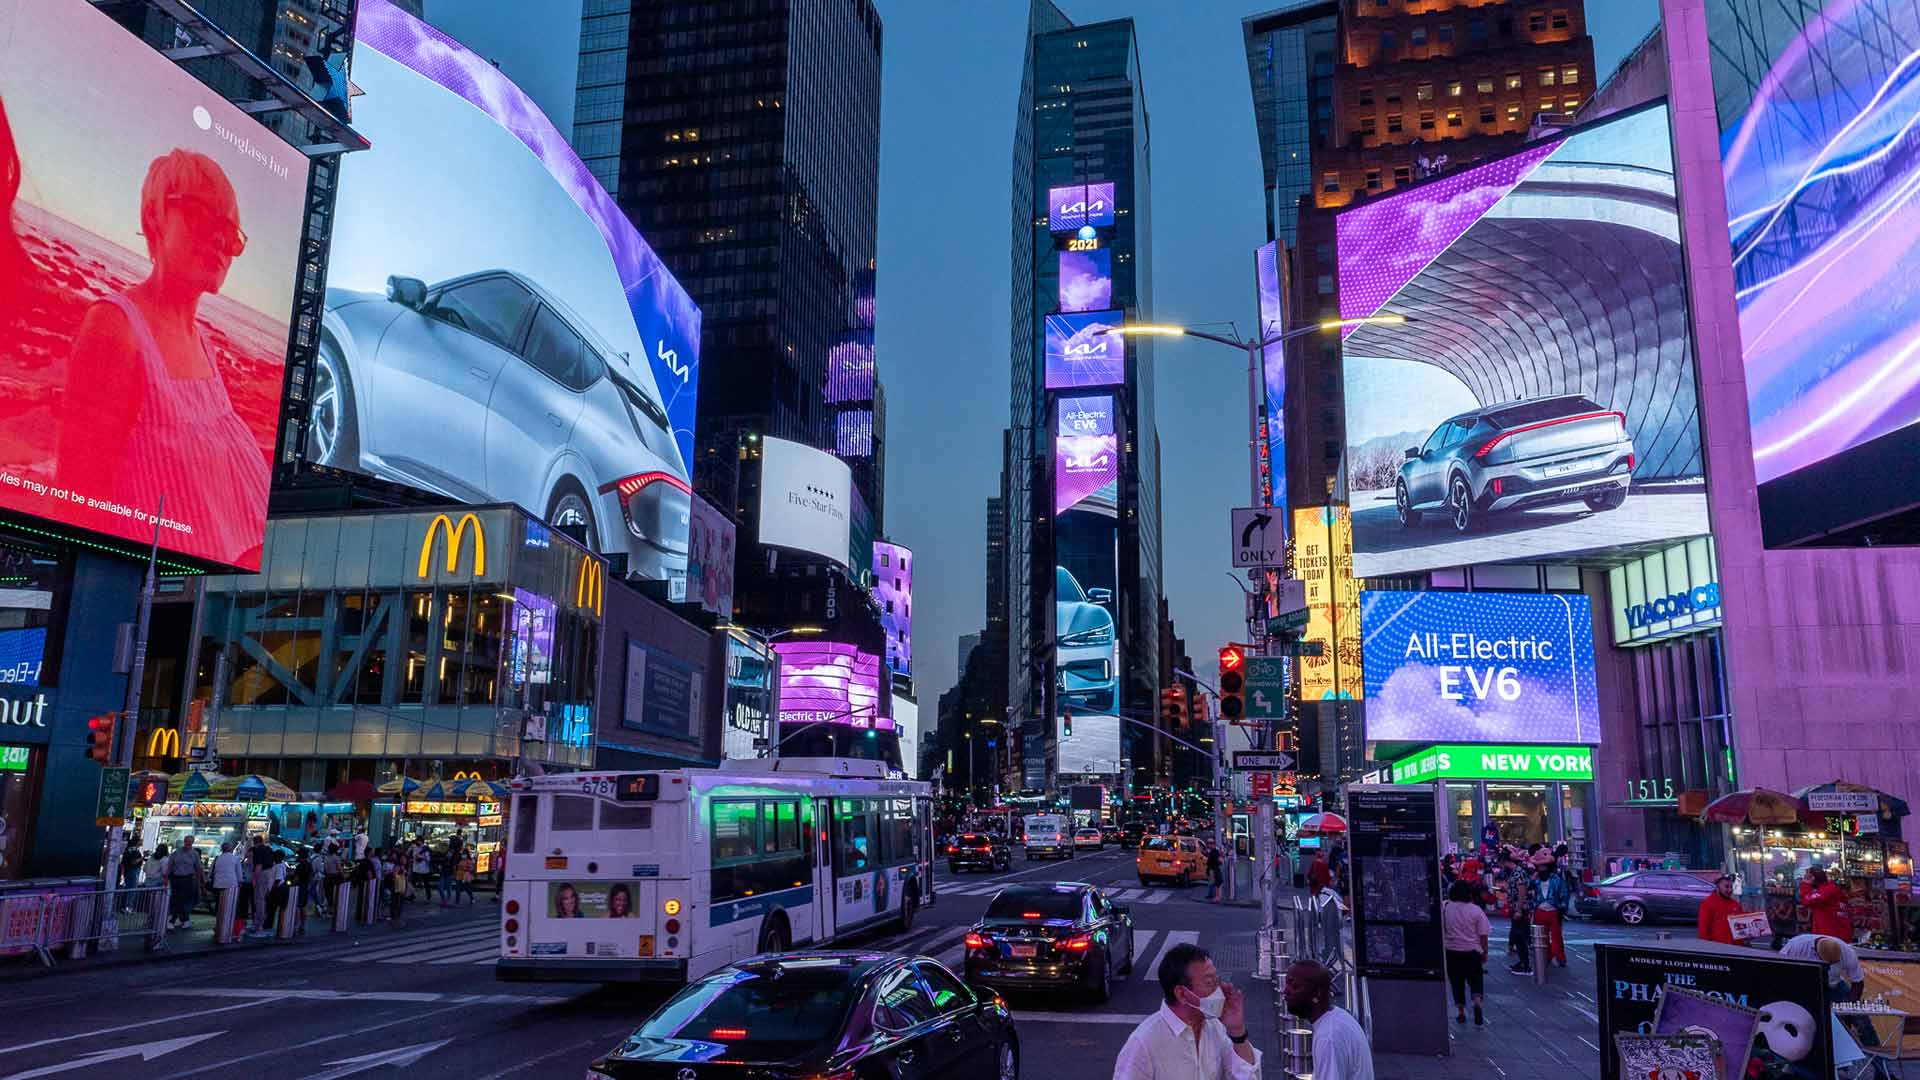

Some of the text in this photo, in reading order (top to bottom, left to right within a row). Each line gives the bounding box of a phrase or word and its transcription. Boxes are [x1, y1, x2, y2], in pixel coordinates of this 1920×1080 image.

[214, 122, 289, 180] sunglass hut
[1068, 239, 1098, 251] 2021
[1064, 341, 1107, 355] KIA
[1065, 411, 1107, 420] All-Electric
[1074, 419, 1097, 430] EV6
[23, 480, 48, 496] may
[50, 487, 69, 500] not
[71, 489, 86, 504] be
[87, 498, 131, 517] available
[134, 508, 148, 521] for
[788, 491, 827, 513] Five-Star
[1240, 550, 1277, 562] ONLY
[1306, 545, 1319, 556] GET
[1299, 556, 1328, 568] TICKETS
[1303, 569, 1325, 580] TODAY
[1310, 587, 1318, 598] AT
[1624, 582, 1720, 629] VIACOMCB
[1405, 632, 1554, 661] All-Electric
[1439, 665, 1522, 702] EV6
[736, 703, 751, 730] OLD
[779, 710, 814, 722] Electric
[1241, 755, 1289, 766] ONE WAY
[1481, 754, 1531, 772] NEW
[1535, 755, 1592, 773] YORK
[582, 780, 616, 794] 6787
[1627, 778, 1674, 801] 1515
[1630, 957, 1731, 971] ANDREW LLOYD WEBBER'S
[1664, 972, 1696, 986] THE
[1614, 980, 1749, 1008] PHAM
